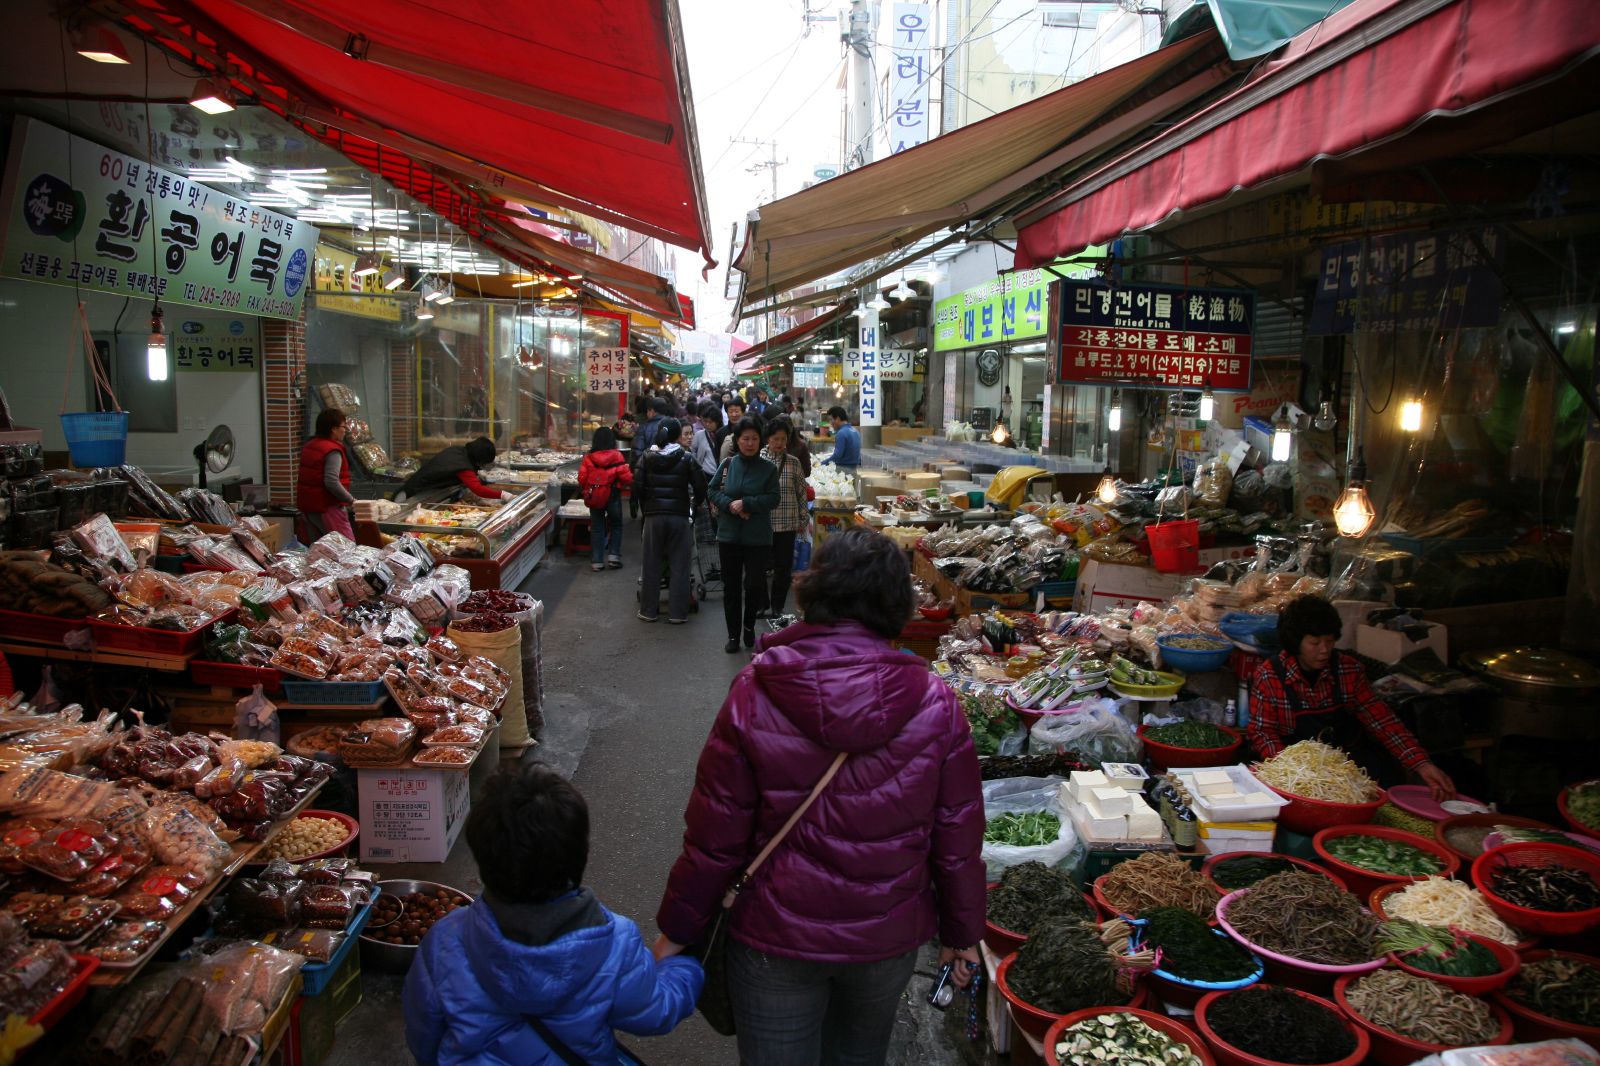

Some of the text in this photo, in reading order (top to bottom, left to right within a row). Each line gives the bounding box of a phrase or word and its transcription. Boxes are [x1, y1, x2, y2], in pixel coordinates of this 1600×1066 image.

[95, 187, 284, 296] 환공어묵
[20, 252, 63, 279] 선물용
[126, 271, 167, 296] 택배전문
[183, 283, 196, 301] TEL
[246, 295, 261, 310] FAX
[1075, 287, 1172, 318] 민경건어물
[963, 287, 1042, 343] 대보선식
[1115, 317, 1171, 329] Dried Fish
[177, 345, 254, 368] 환공어묵
[588, 350, 626, 362] 추어탕
[846, 351, 911, 369] 우분식
[1216, 358, 1241, 375] 전문
[588, 363, 626, 376] 선지국
[861, 327, 876, 419] 대보선식
[589, 378, 627, 391] 감자탕
